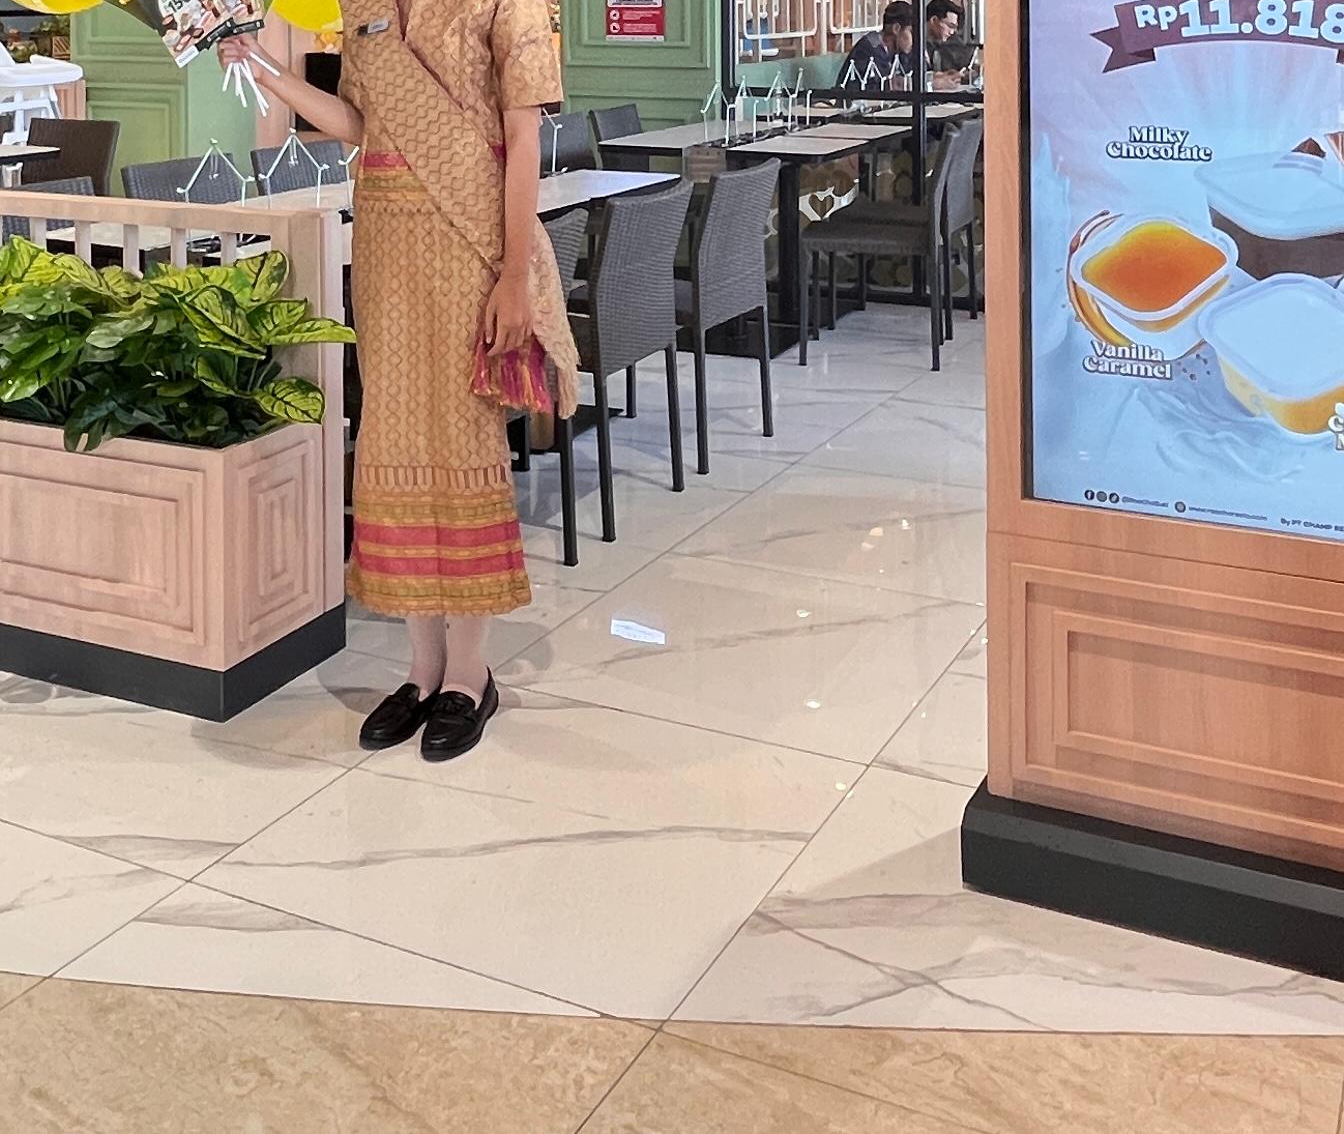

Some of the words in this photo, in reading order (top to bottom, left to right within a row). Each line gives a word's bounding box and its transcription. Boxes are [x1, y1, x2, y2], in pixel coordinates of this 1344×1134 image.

[1129, 125, 1189, 146] Milky
[1106, 141, 1212, 162] Chocolate
[1090, 340, 1164, 362] Vanilla
[1083, 355, 1173, 380] Caramel
